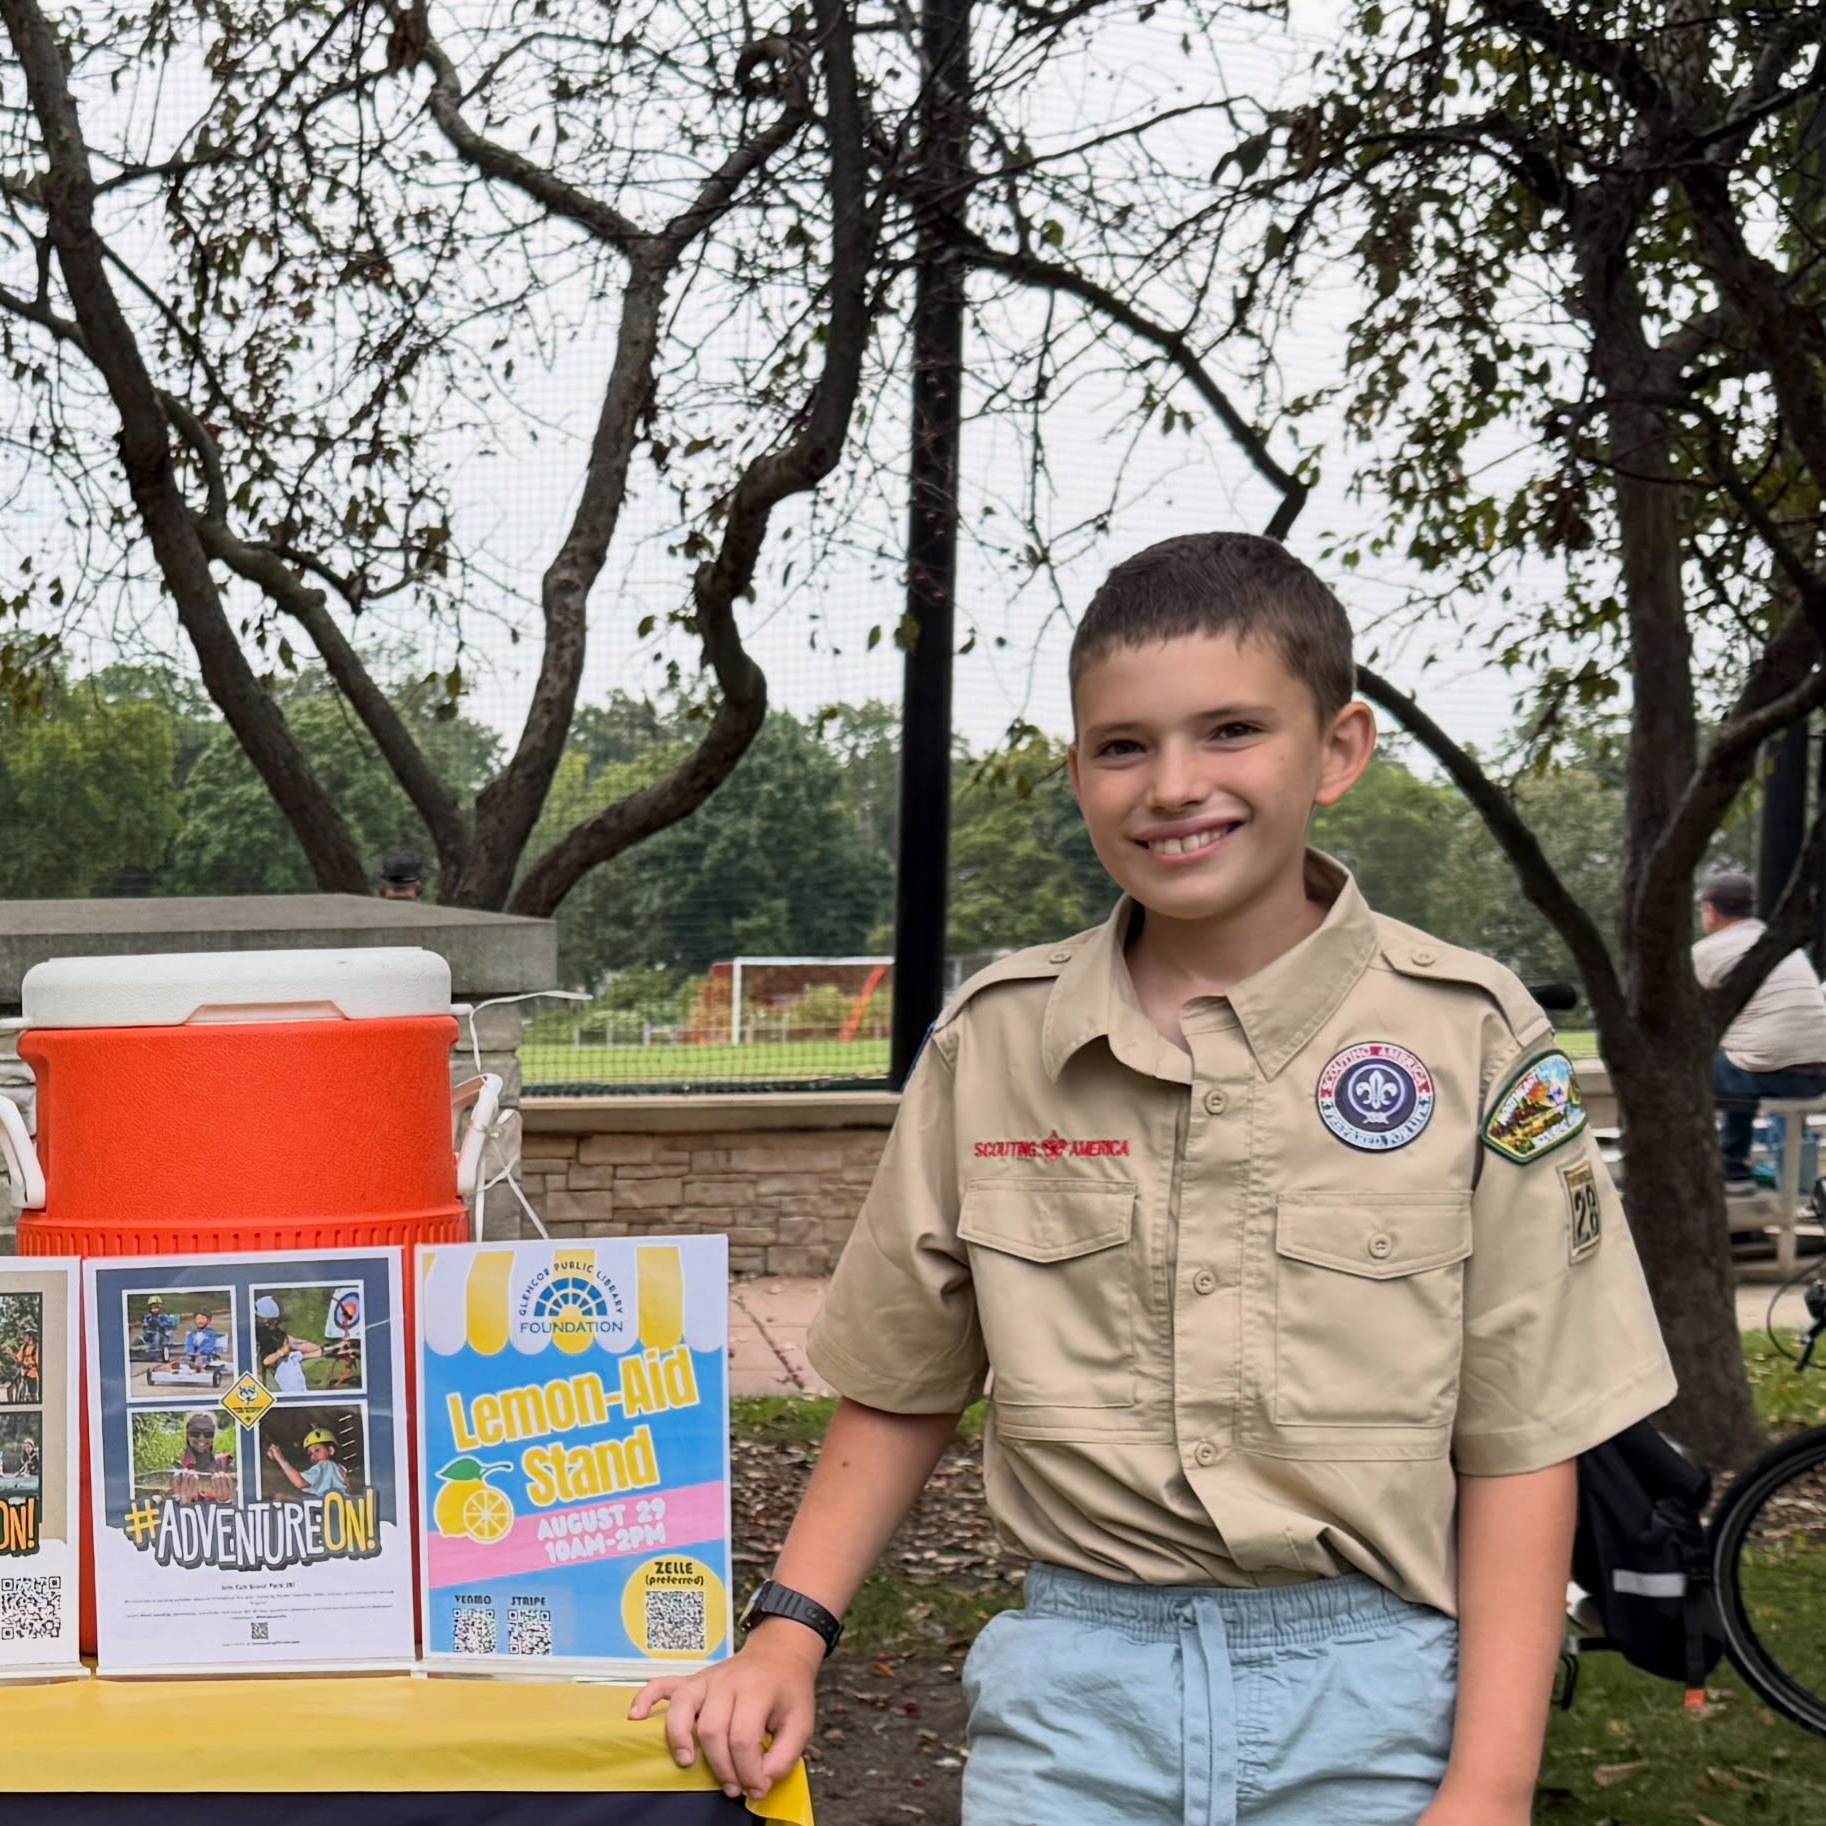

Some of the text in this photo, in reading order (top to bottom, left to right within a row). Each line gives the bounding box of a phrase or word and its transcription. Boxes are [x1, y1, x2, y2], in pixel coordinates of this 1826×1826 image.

[974, 1140, 1131, 1158] SCOUTING AMERICA
[1574, 1184, 1600, 1245] 28
[519, 1260, 624, 1317] GLENCOE PUBLIC LIBRARY
[520, 1321, 623, 1334] FOUNDATION
[447, 1346, 700, 1451] Lemon-Aid
[522, 1424, 660, 1506] Stand
[537, 1498, 667, 1542] AUGUST 29
[545, 1522, 666, 1563] 10AM-2PM
[645, 1574, 704, 1586] (preferred)
[655, 1562, 693, 1574] ZELLE
[454, 1594, 492, 1605] VENMO
[511, 1596, 546, 1606] STRIPE
